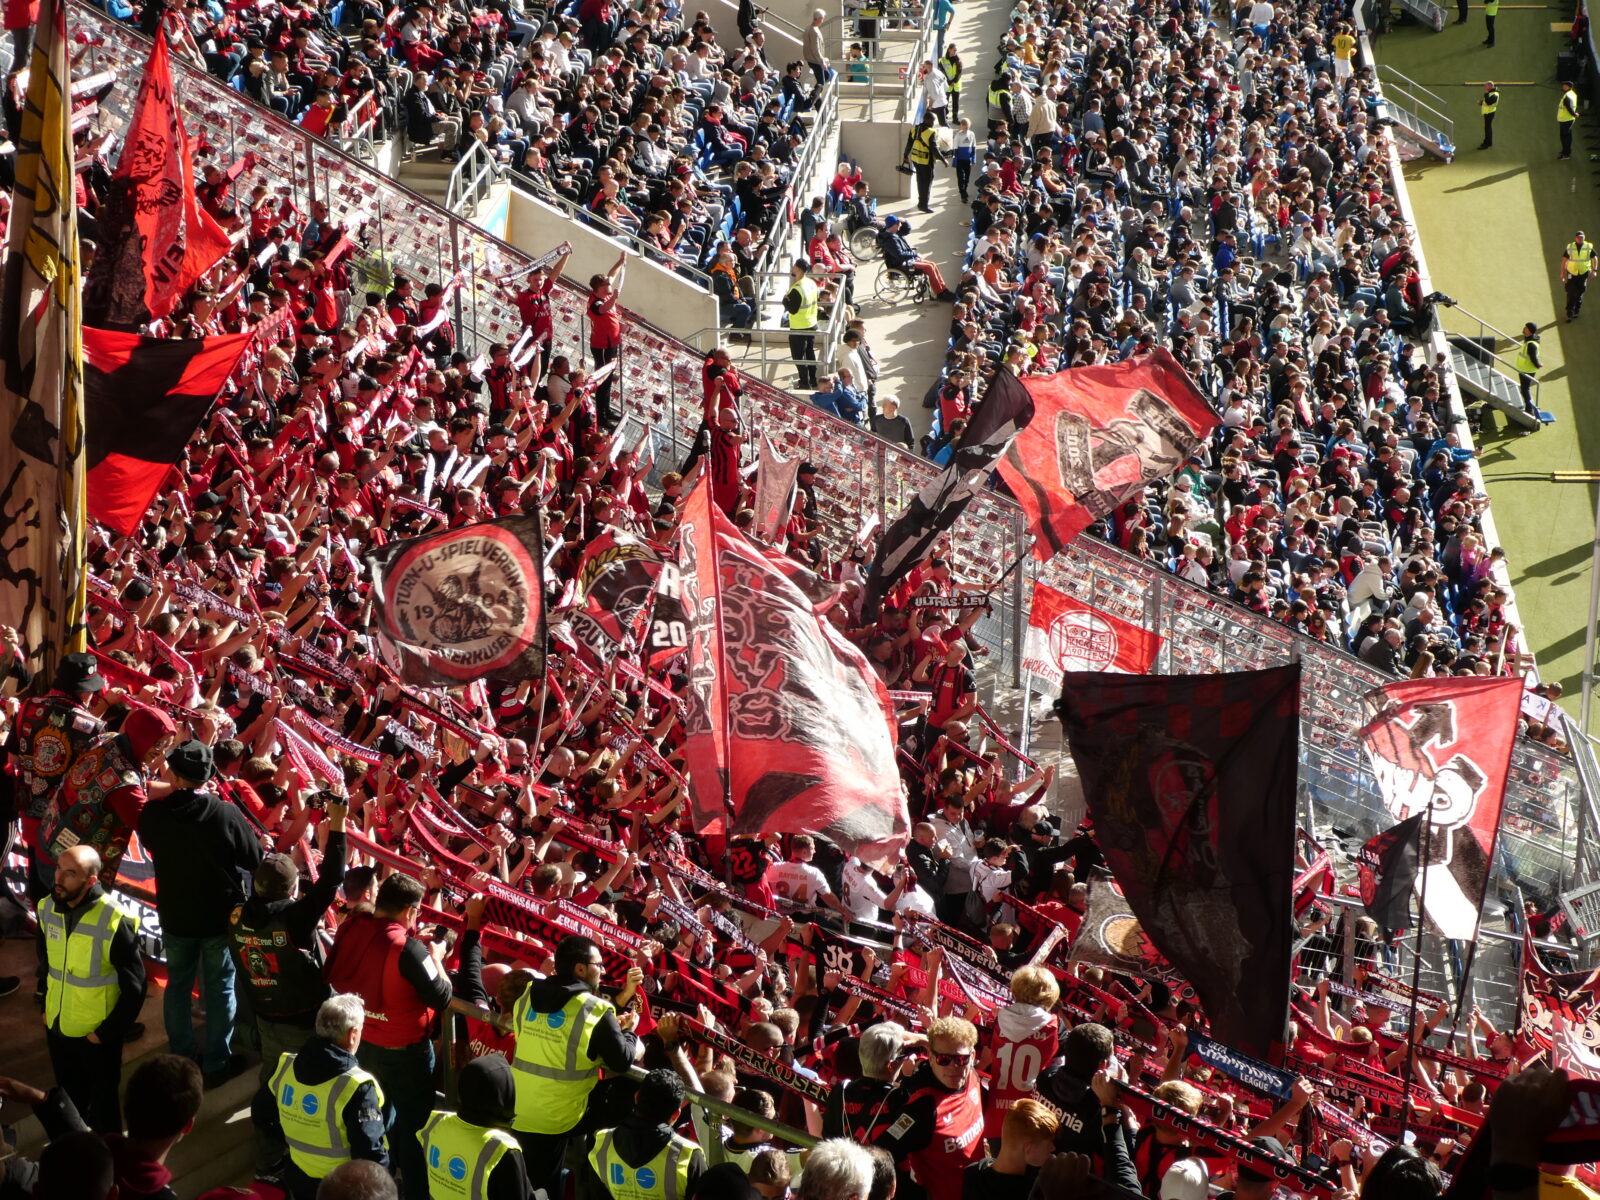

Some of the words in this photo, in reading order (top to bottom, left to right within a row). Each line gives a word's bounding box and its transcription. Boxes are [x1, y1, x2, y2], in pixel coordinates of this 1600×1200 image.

[396, 539, 523, 606] TURN-U-SPIELVEREIN
[414, 605, 434, 619] 19
[914, 596, 958, 607] ULTRAS
[1069, 638, 1107, 651] KICKERS
[1022, 656, 1060, 682] KICKERS
[488, 884, 540, 915] GEMEINSAM
[934, 931, 1013, 981] club.bayer04.d
[1208, 1040, 1227, 1055] UEFA
[702, 1028, 831, 1101] LEVERKUSEN
[996, 1042, 1042, 1092] 10
[1240, 1072, 1269, 1092] LEAGUE
